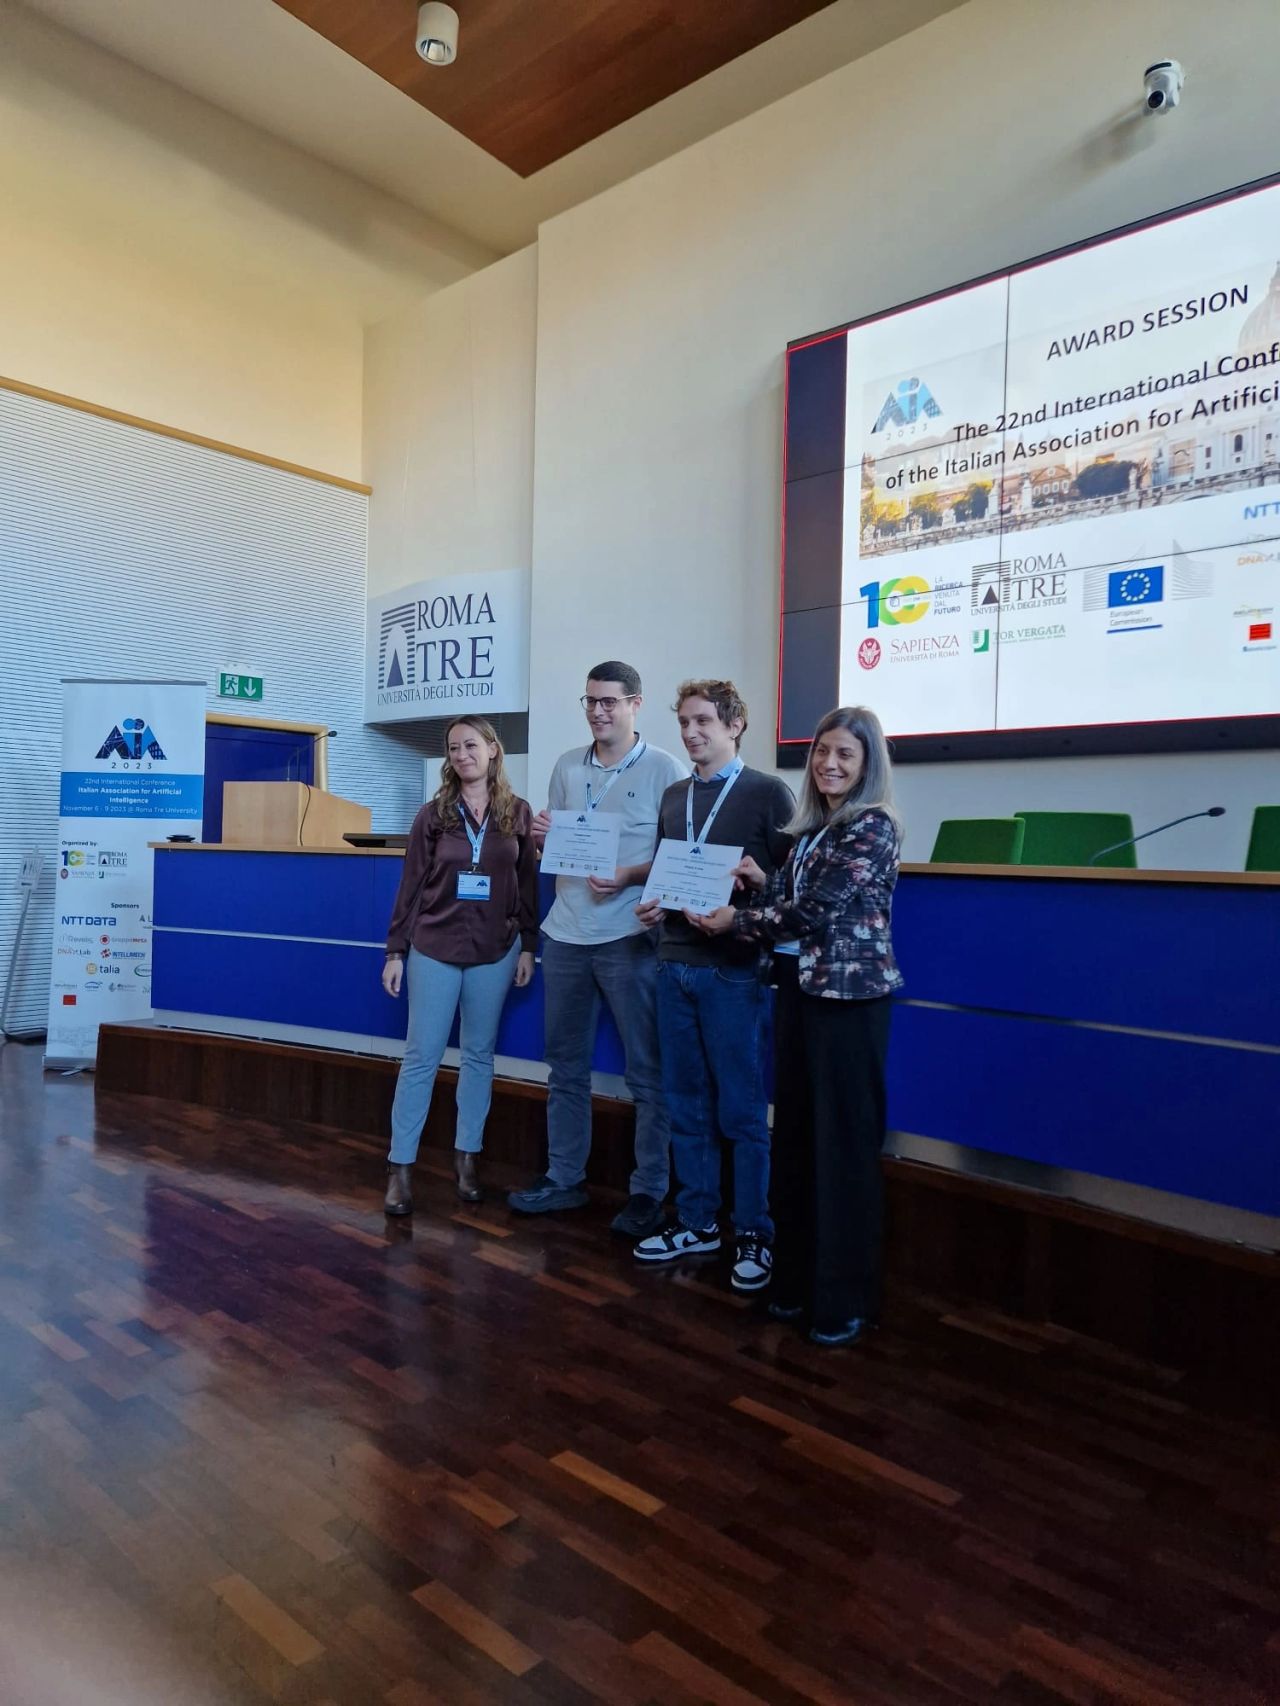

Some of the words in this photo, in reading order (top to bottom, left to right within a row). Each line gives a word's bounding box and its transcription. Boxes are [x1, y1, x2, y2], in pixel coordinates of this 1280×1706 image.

[1047, 319, 1135, 361] AWARD
[1142, 284, 1249, 333] SESSION
[954, 422, 989, 442] The
[996, 403, 1047, 432] 22nd
[1055, 361, 1208, 419] International
[1218, 342, 1280, 377] Conf
[886, 470, 904, 490] of
[909, 463, 939, 485] the
[945, 449, 1006, 478] Italian
[1013, 417, 1140, 460] Association
[1148, 407, 1184, 430] for
[1012, 552, 1067, 576] ROMA
[1012, 573, 1066, 602] TRE
[417, 592, 496, 631] ROMA
[934, 606, 961, 616] FUTURO
[1017, 624, 1066, 638] VERGATA
[891, 635, 960, 655] SAPIENZA
[416, 636, 495, 683] TRE
[377, 684, 421, 706] UNIVERSITÀ
[423, 685, 453, 701] DEGLI
[457, 682, 495, 698] STUDI
[111, 762, 152, 770] 2023
[109, 797, 149, 805] Intelligence
[62, 916, 84, 925] NTT
